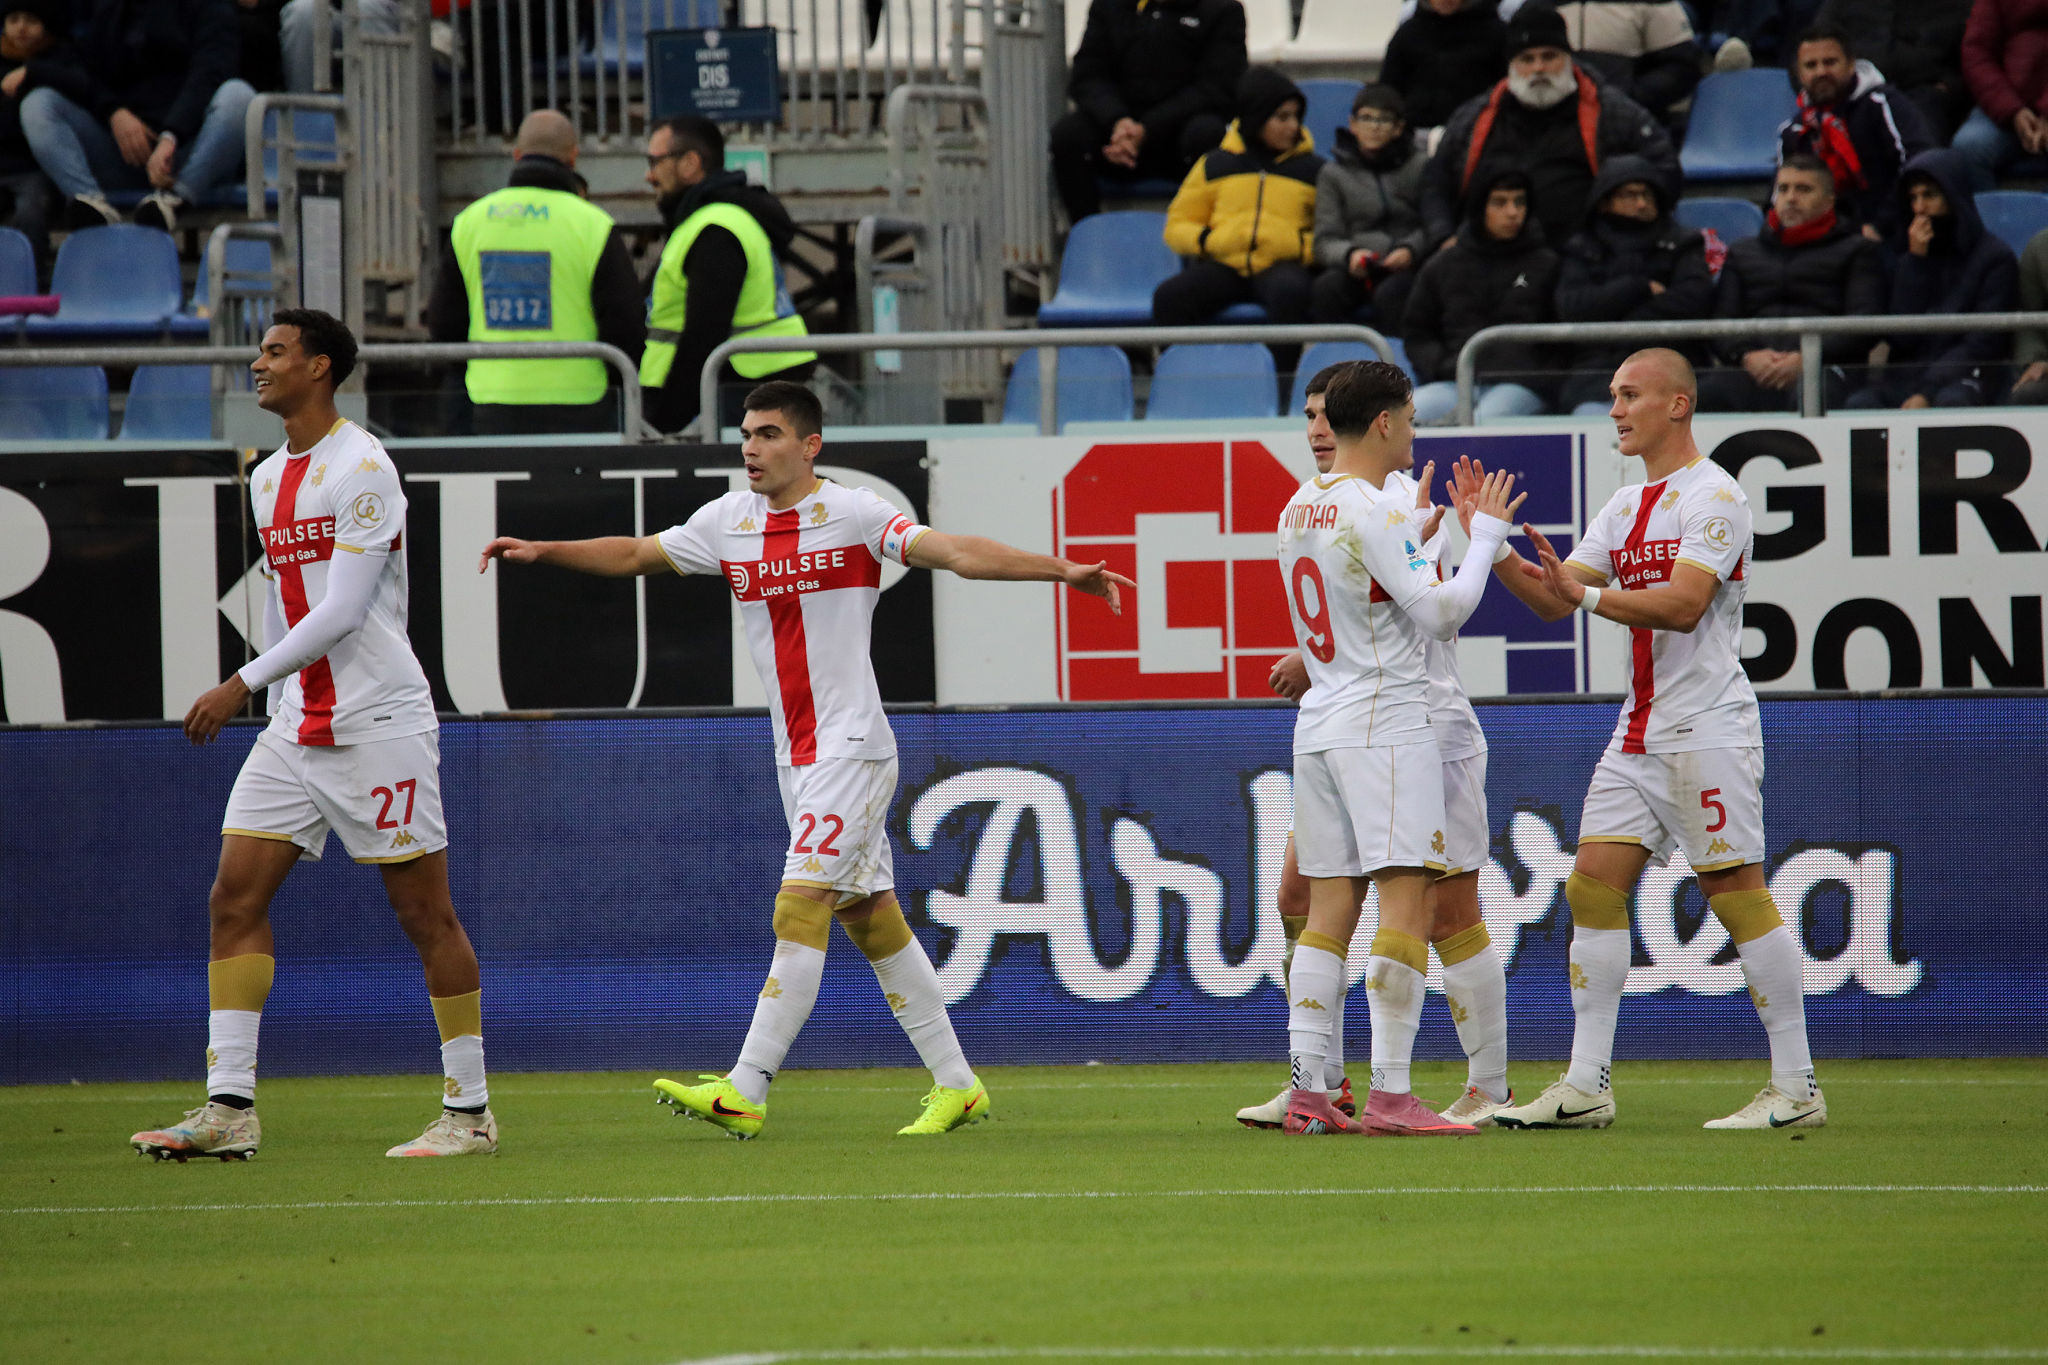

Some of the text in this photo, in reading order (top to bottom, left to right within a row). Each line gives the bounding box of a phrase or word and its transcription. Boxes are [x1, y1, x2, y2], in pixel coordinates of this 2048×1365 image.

[1709, 425, 2048, 562] GIR
[269, 521, 335, 547] PULSEE
[289, 553, 295, 562] e
[296, 549, 318, 561] Gas
[758, 550, 845, 579] PULSEE
[760, 580, 820, 597] Luce e Gas
[1642, 569, 1662, 580] Gas
[1292, 556, 1336, 664] 9
[370, 778, 417, 831] 27
[1701, 788, 1727, 833] 5
[794, 812, 844, 857] 22
